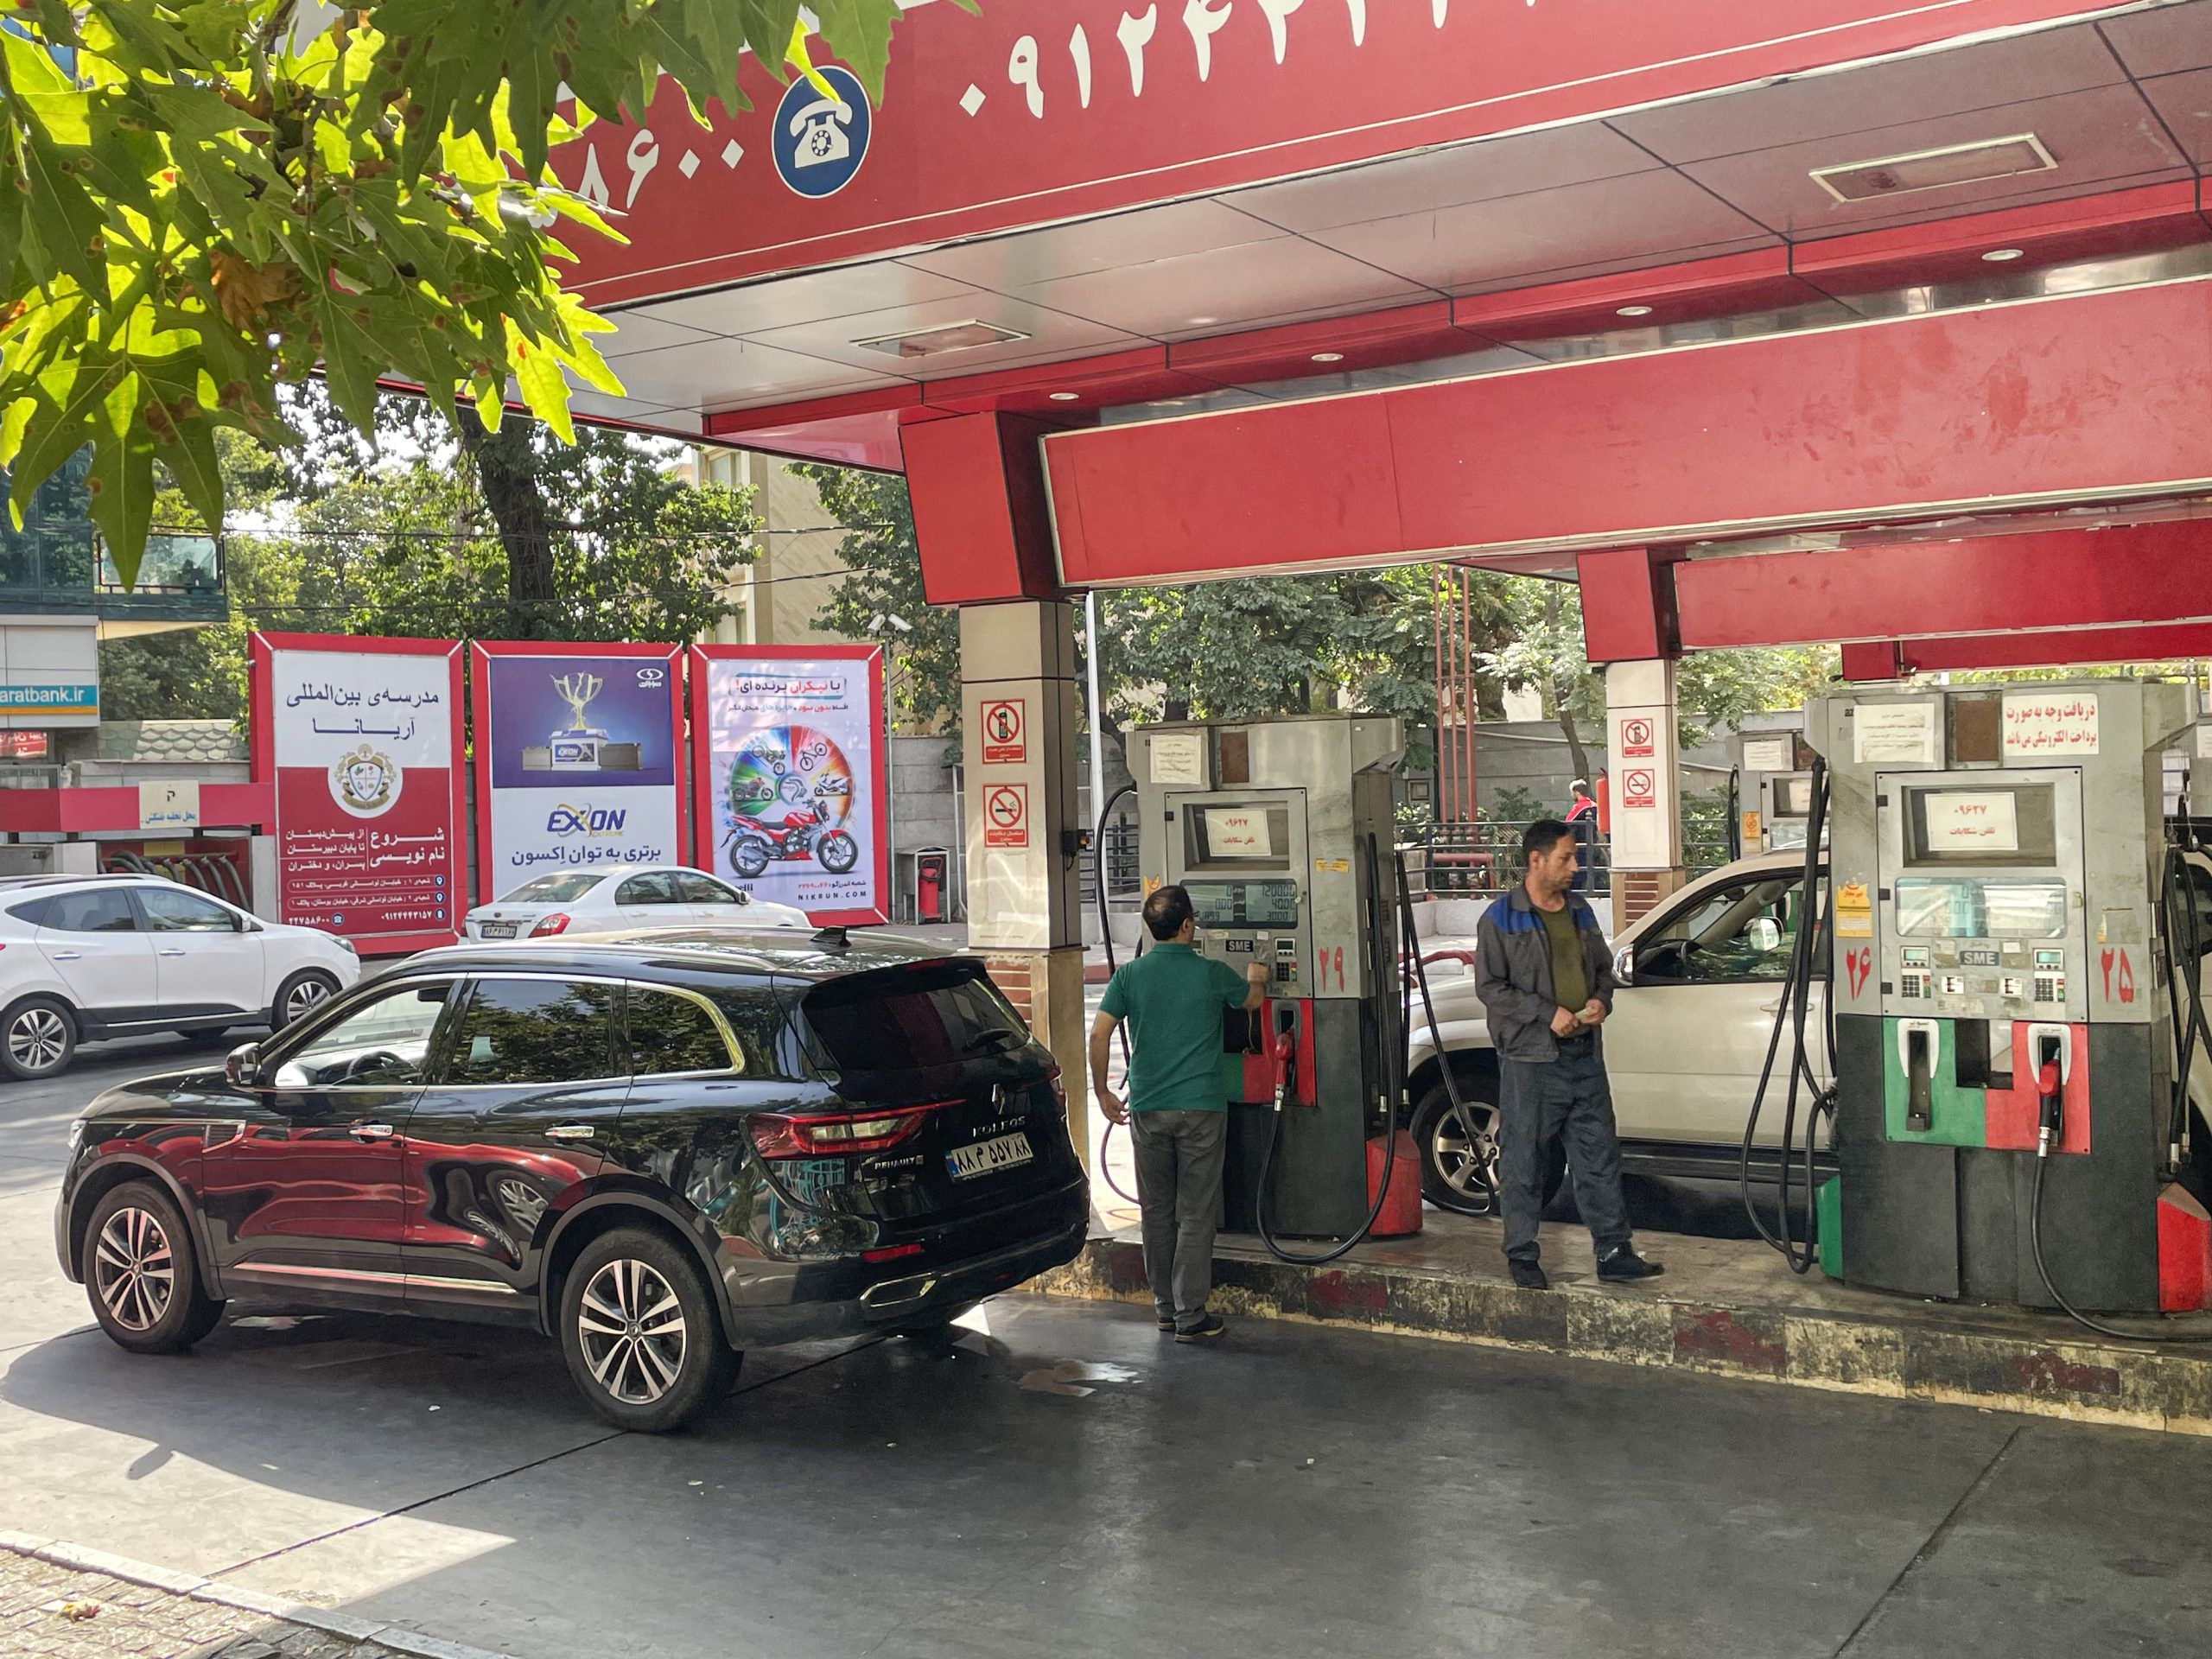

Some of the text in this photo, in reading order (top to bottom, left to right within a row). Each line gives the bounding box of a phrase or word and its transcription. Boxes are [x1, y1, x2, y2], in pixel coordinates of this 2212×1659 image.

[755, 680, 787, 694] برنده
[830, 679, 841, 693] با
[370, 827, 445, 849] شروع
[370, 847, 446, 868] نام نویسی
[569, 846, 602, 864] توان
[606, 847, 620, 863] به
[624, 846, 662, 862] برتری
[288, 860, 322, 872] دختران
[1228, 941, 1251, 951] SME
[1963, 951, 1996, 965] SME
[1846, 946, 1872, 1002] ۲۶
[2100, 946, 2136, 1004] ۲۵
